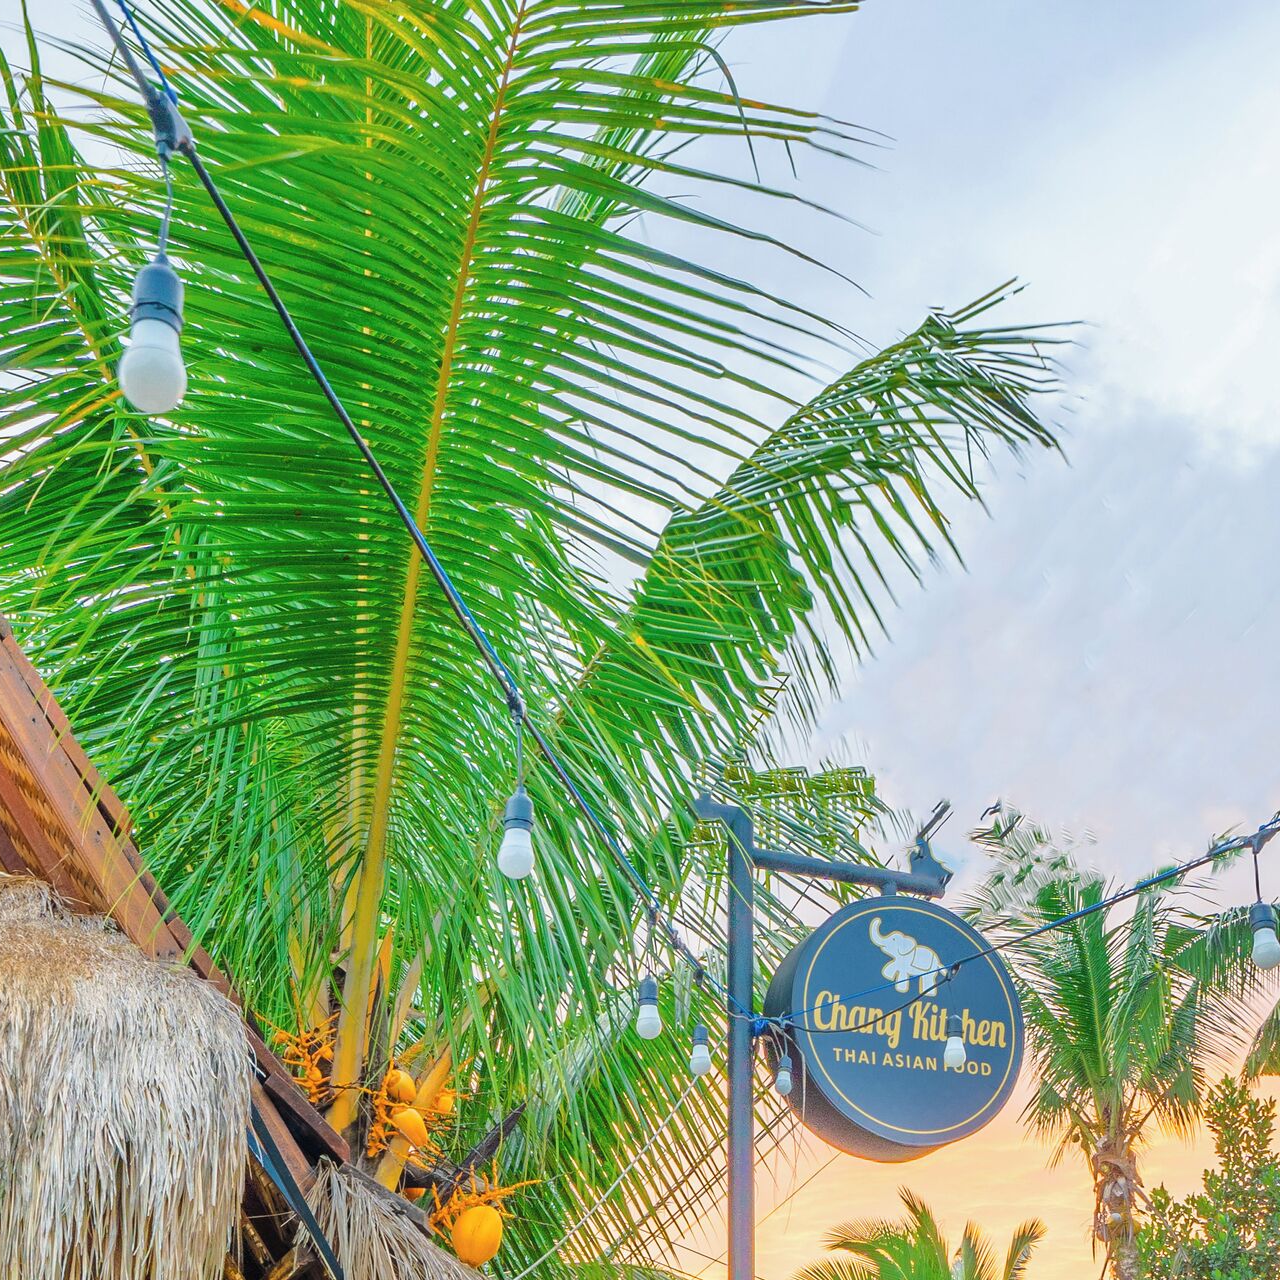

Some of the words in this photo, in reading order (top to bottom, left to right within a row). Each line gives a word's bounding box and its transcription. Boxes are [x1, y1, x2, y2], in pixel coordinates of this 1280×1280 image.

[813, 990, 903, 1049] Chang
[909, 1000, 1007, 1048] Kithen
[832, 1047, 877, 1065] THAI
[882, 1052, 937, 1072] ASIAN
